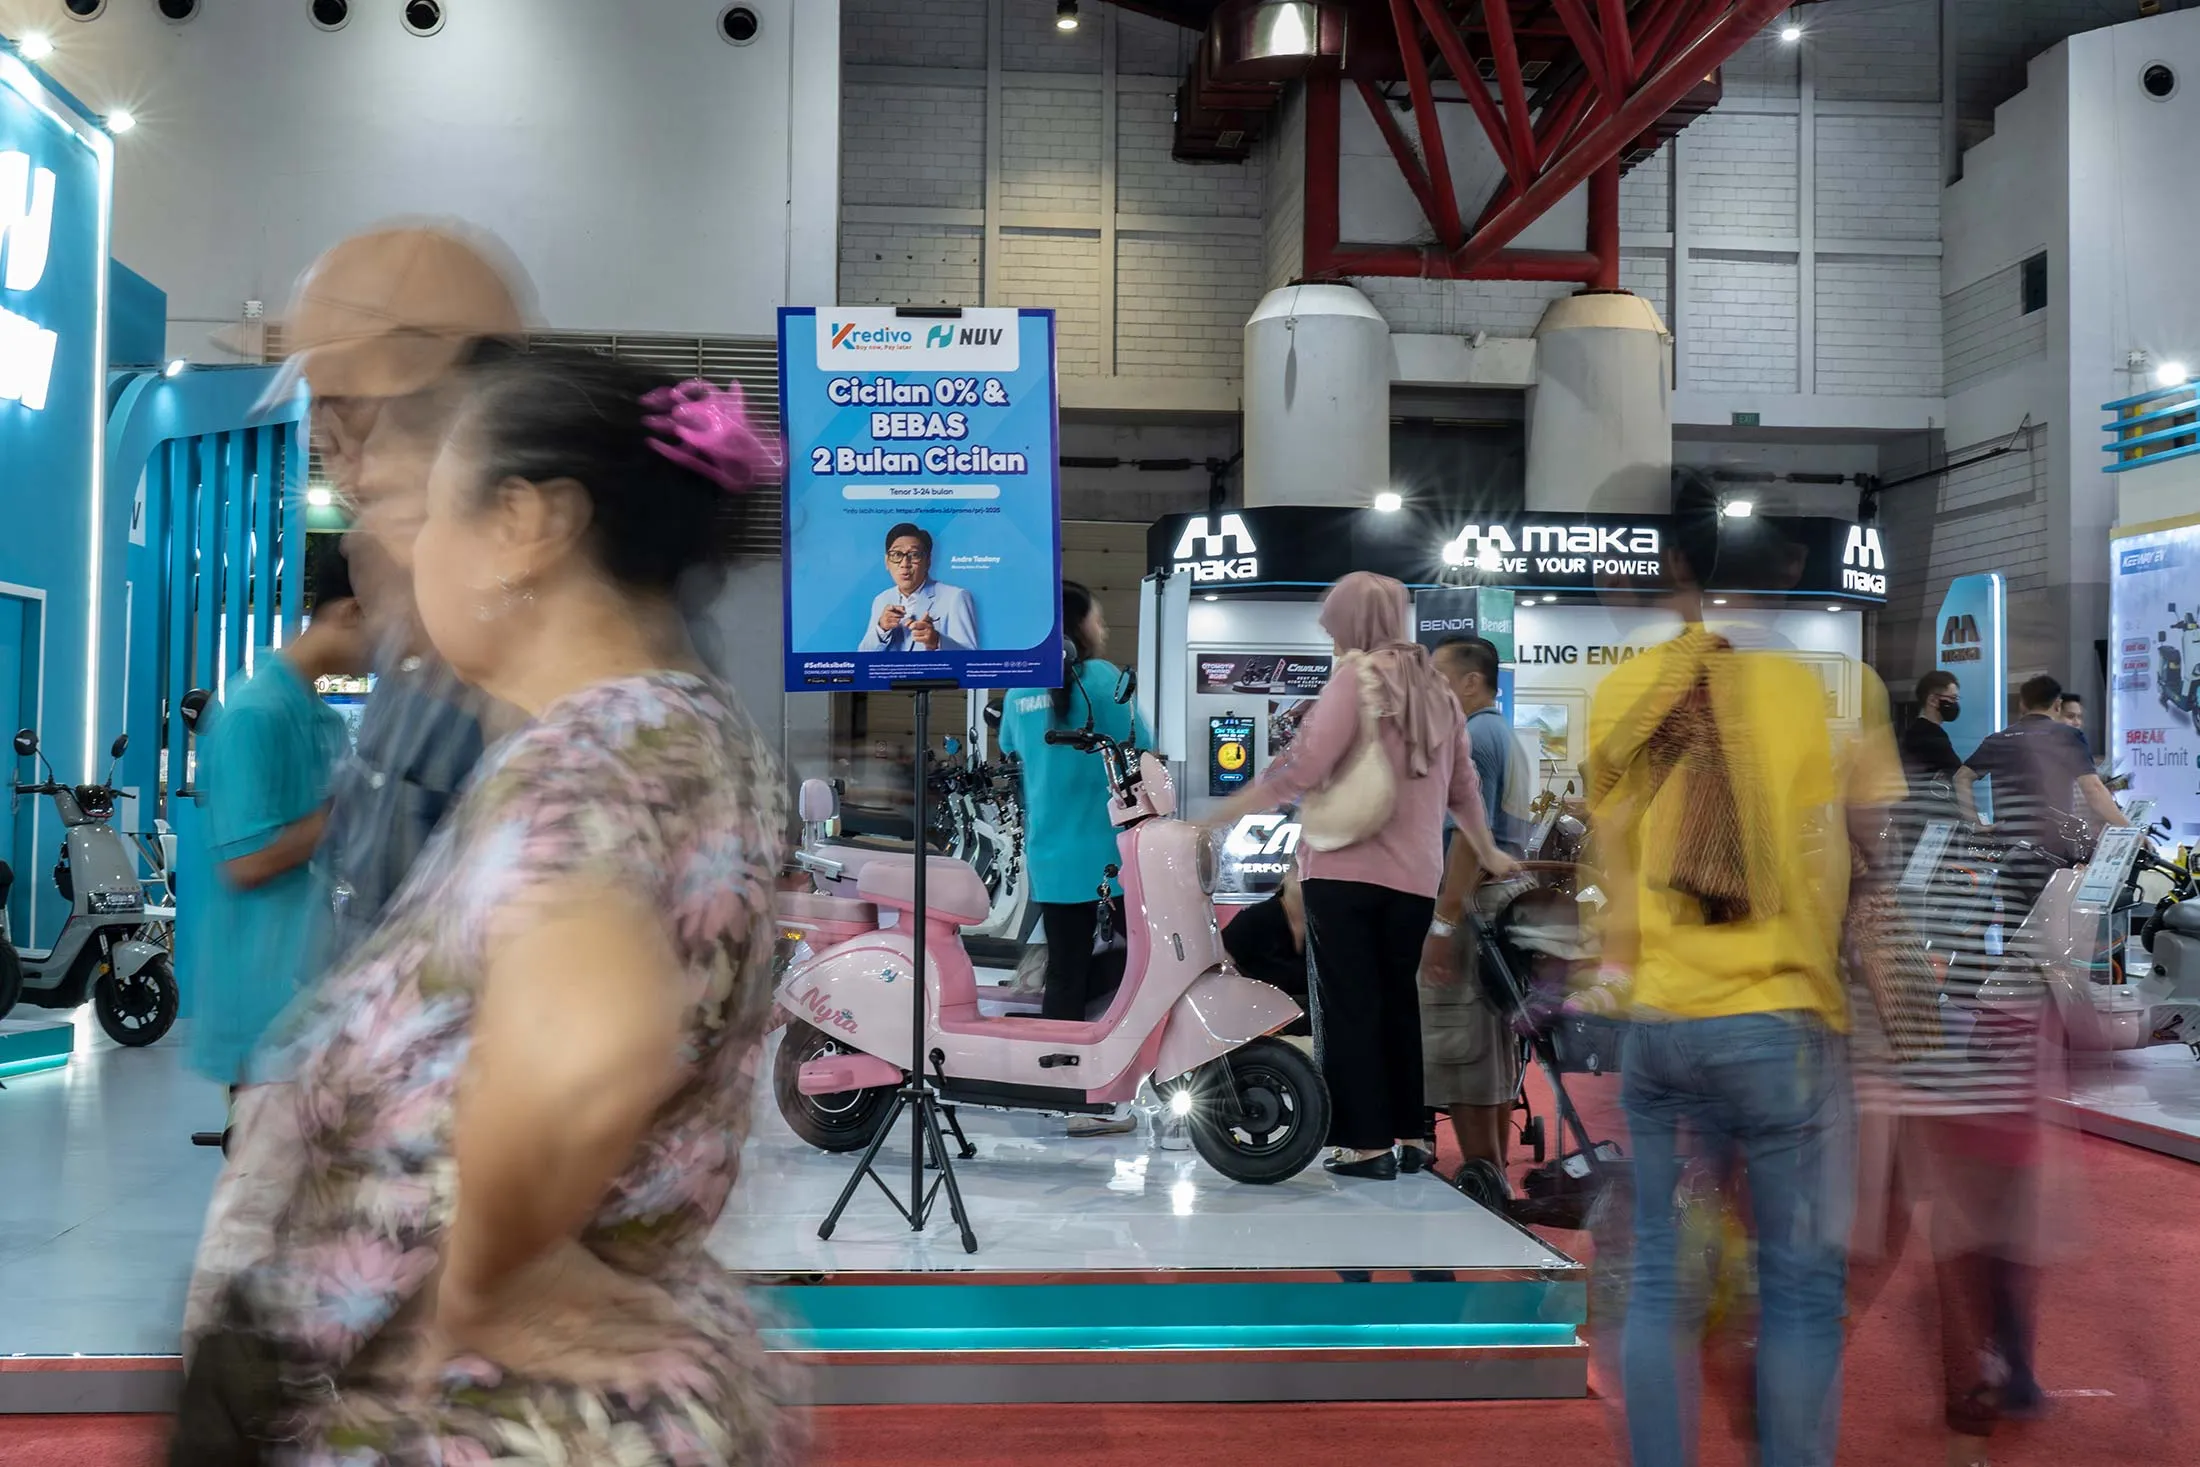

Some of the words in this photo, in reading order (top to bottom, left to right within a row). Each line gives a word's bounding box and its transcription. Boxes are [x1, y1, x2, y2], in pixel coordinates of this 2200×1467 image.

[832, 323, 912, 349] Kredivo
[959, 328, 1003, 345] NUV
[828, 377, 931, 406] Cicilan
[934, 378, 980, 406] 0%
[982, 378, 1010, 406] &
[871, 412, 968, 440] BEBAS
[811, 447, 834, 475] 2
[835, 447, 923, 475] Bulan
[924, 445, 1028, 475] Cicilan
[889, 488, 912, 496] Tenor
[912, 488, 931, 496] 3-24
[931, 487, 954, 496] bulan
[1522, 526, 1660, 554] maka
[1174, 557, 1258, 582] maka
[1535, 557, 1587, 573] YOUR
[1592, 559, 1660, 576] POWER
[1843, 569, 1886, 594] maka
[1420, 618, 1475, 632] BENDA
[1514, 645, 1578, 665] LING
[1586, 646, 1646, 665] ENA
[2126, 729, 2166, 745] BREAK
[2132, 748, 2155, 767] The
[2157, 747, 2189, 767] Limit
[800, 987, 858, 1034] Nyra
